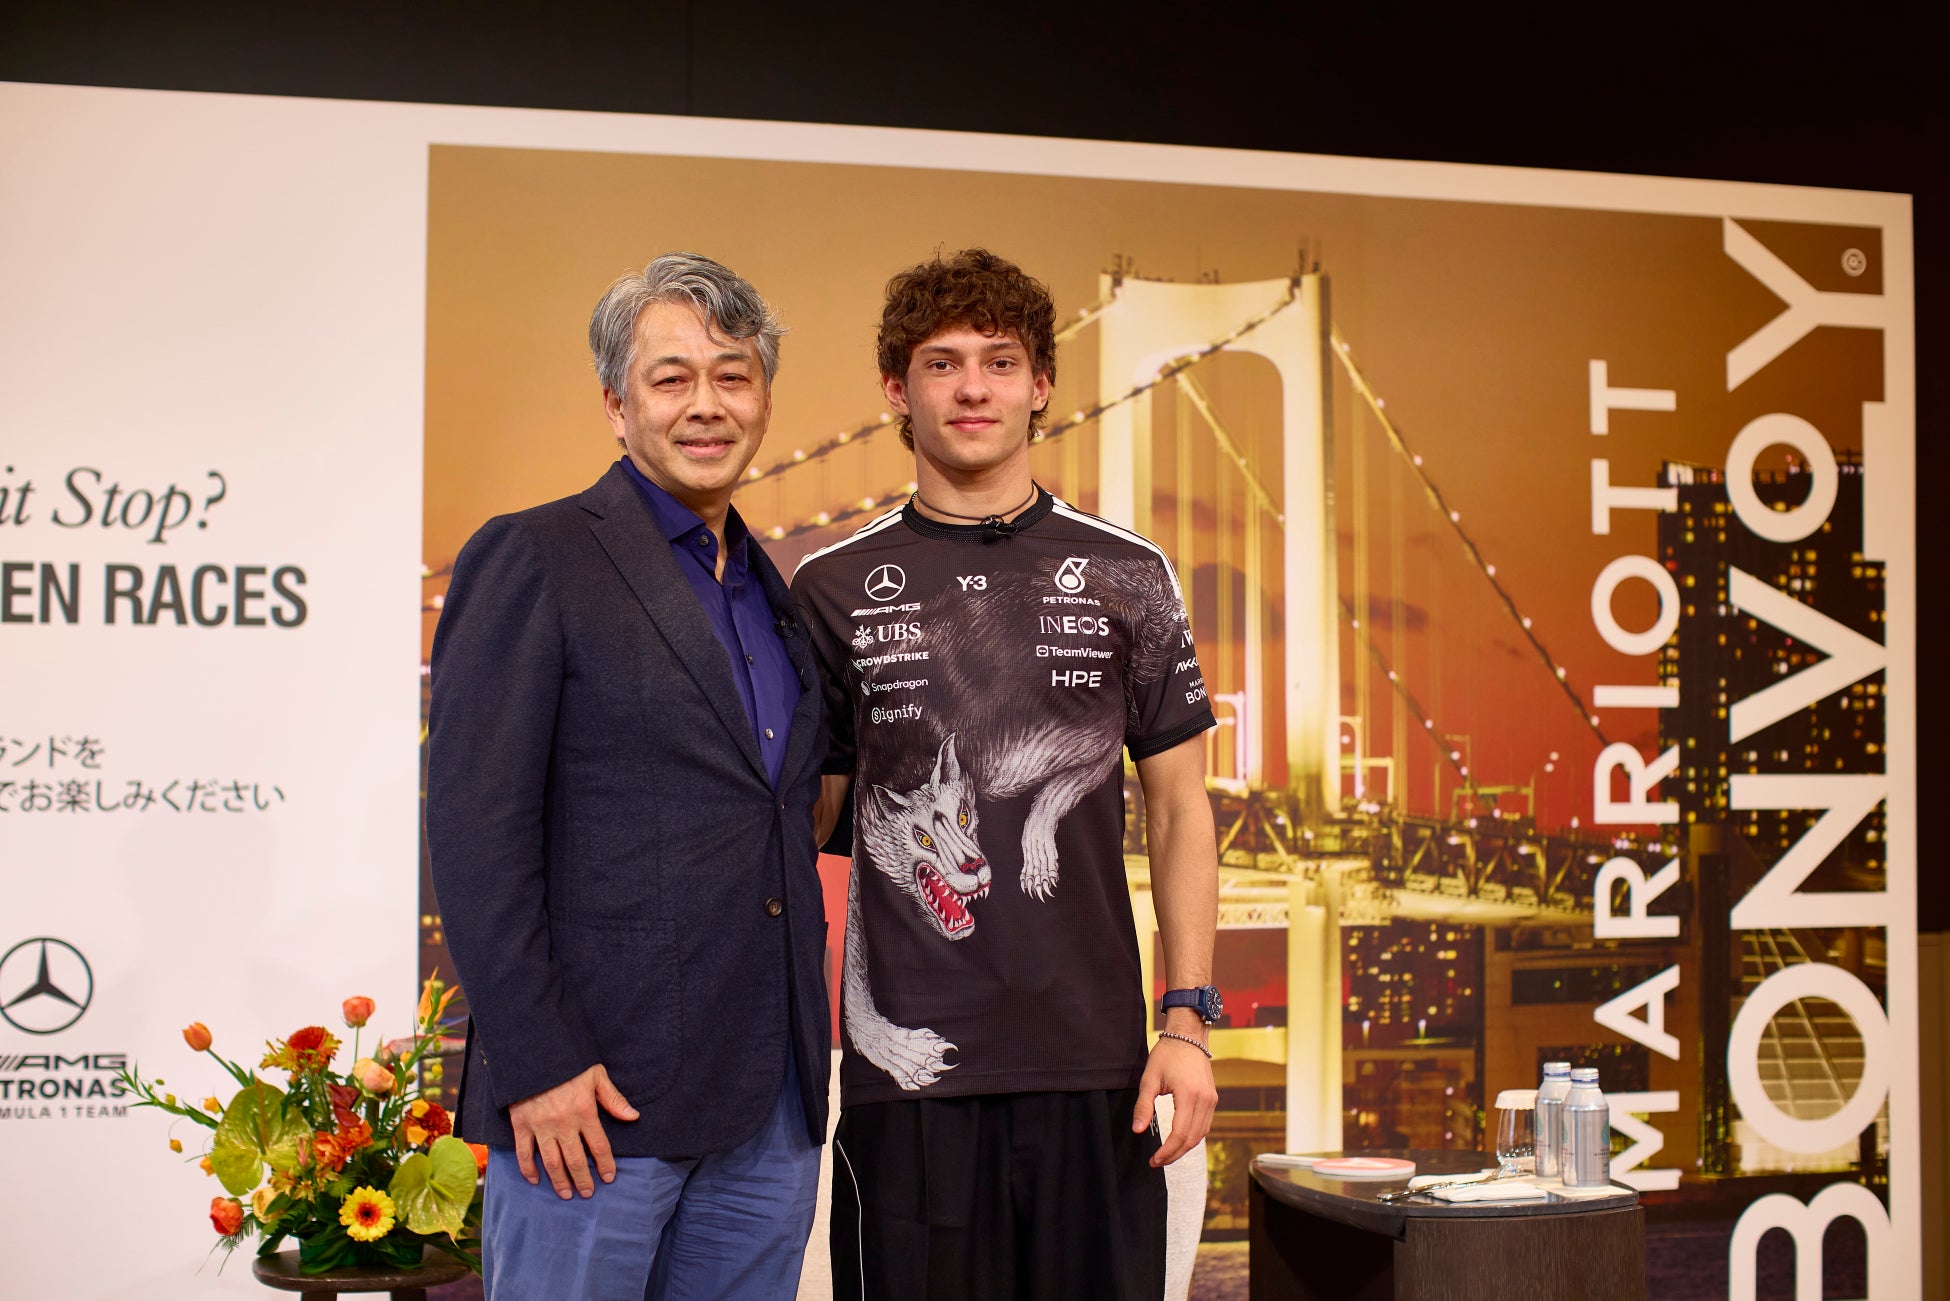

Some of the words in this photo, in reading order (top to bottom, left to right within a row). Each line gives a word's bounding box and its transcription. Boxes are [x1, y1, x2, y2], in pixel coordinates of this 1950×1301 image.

[51, 467, 227, 544] Stop?
[956, 575, 988, 591] Y-3
[0, 562, 80, 624] EN
[103, 564, 308, 628] RACES
[1042, 596, 1101, 606] PETRONAS
[877, 622, 922, 642] UBS
[1039, 615, 1110, 636] INEOS
[857, 651, 930, 668] CROWDSTRIKE
[1049, 646, 1114, 659] TeamViewer
[871, 678, 929, 693] Snapdragon
[1051, 669, 1103, 688] HPE
[1723, 217, 1894, 1301] BONVOY
[1589, 359, 1681, 1191] MARRIOTT
[74, 1106, 128, 1118] TEAM
